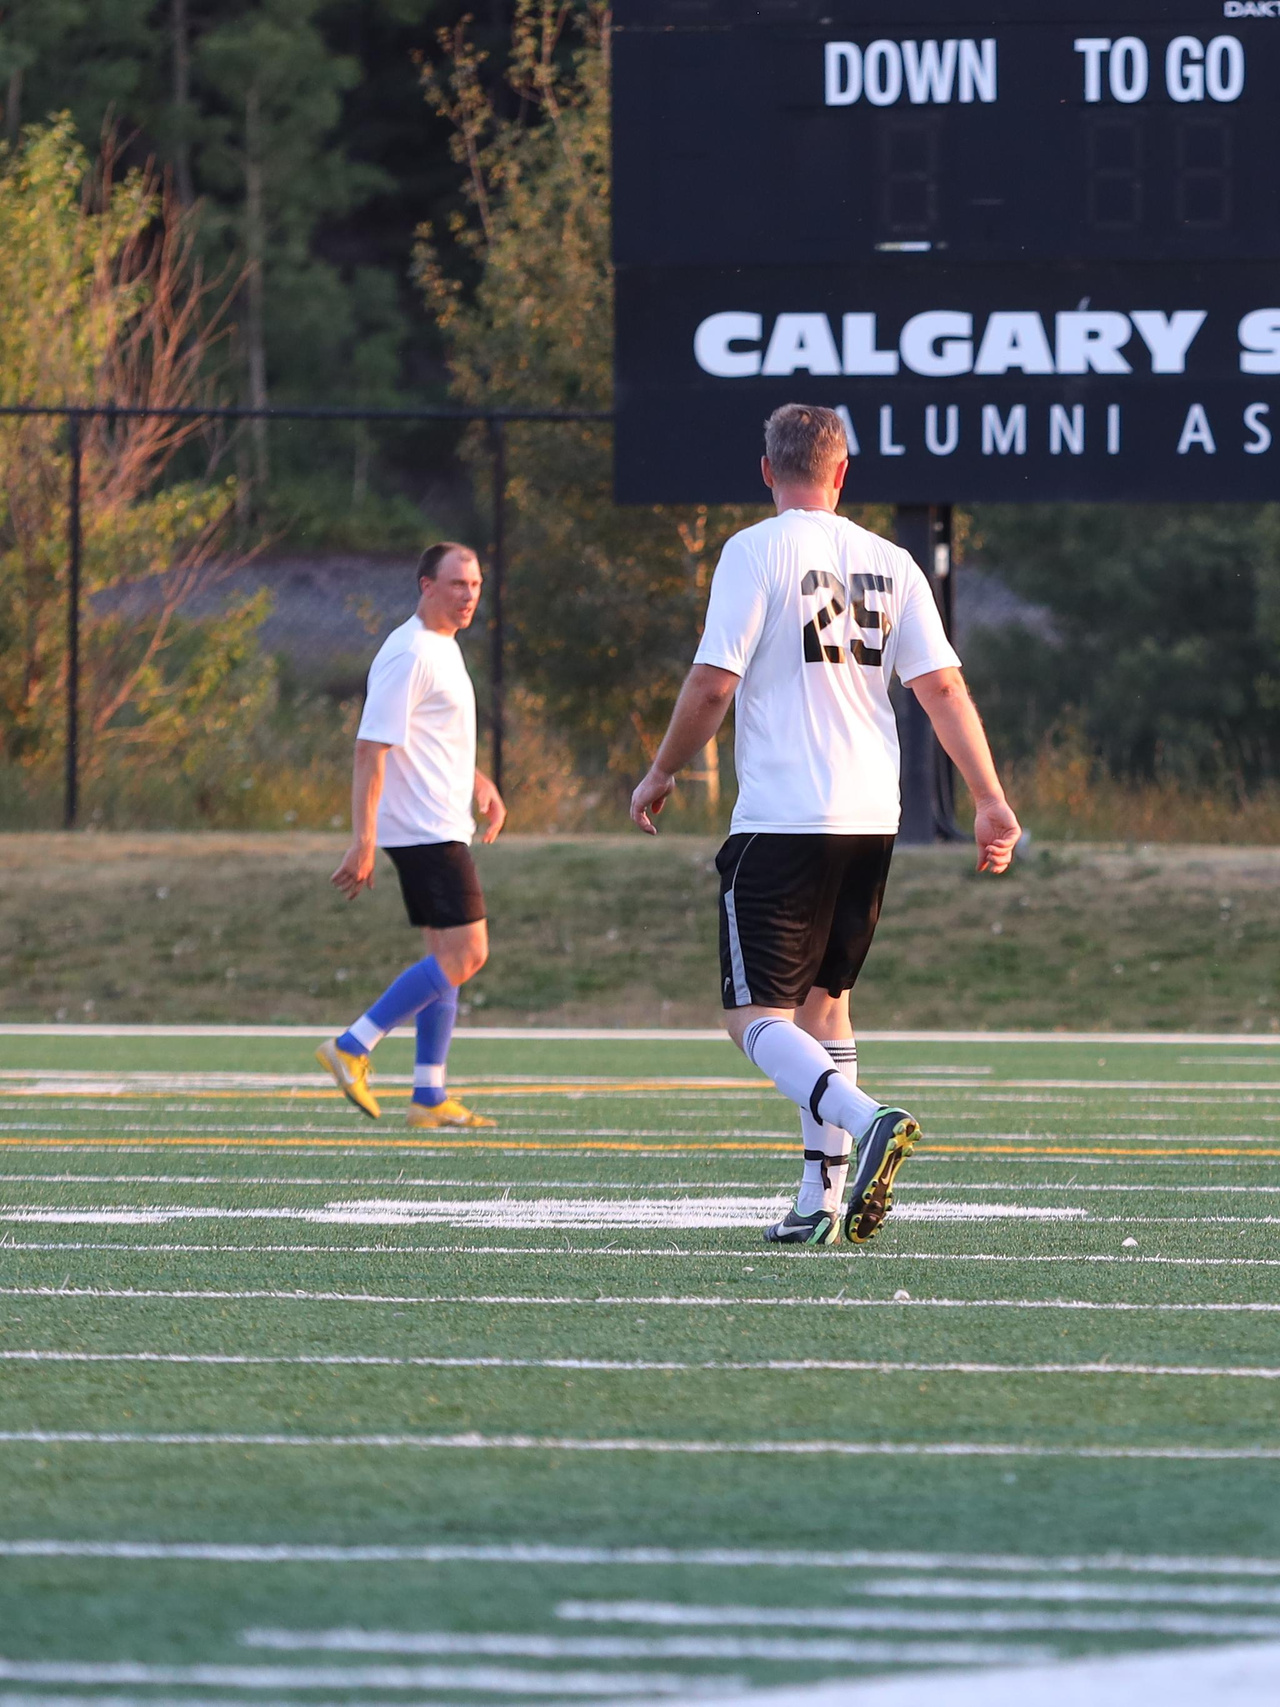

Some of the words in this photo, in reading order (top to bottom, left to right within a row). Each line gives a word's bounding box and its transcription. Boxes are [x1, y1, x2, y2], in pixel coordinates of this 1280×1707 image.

[825, 39, 997, 105] DOWN
[1074, 37, 1148, 102] TO
[1165, 36, 1244, 102] GO
[694, 311, 1207, 377] CALGARY
[801, 570, 892, 667] 25
